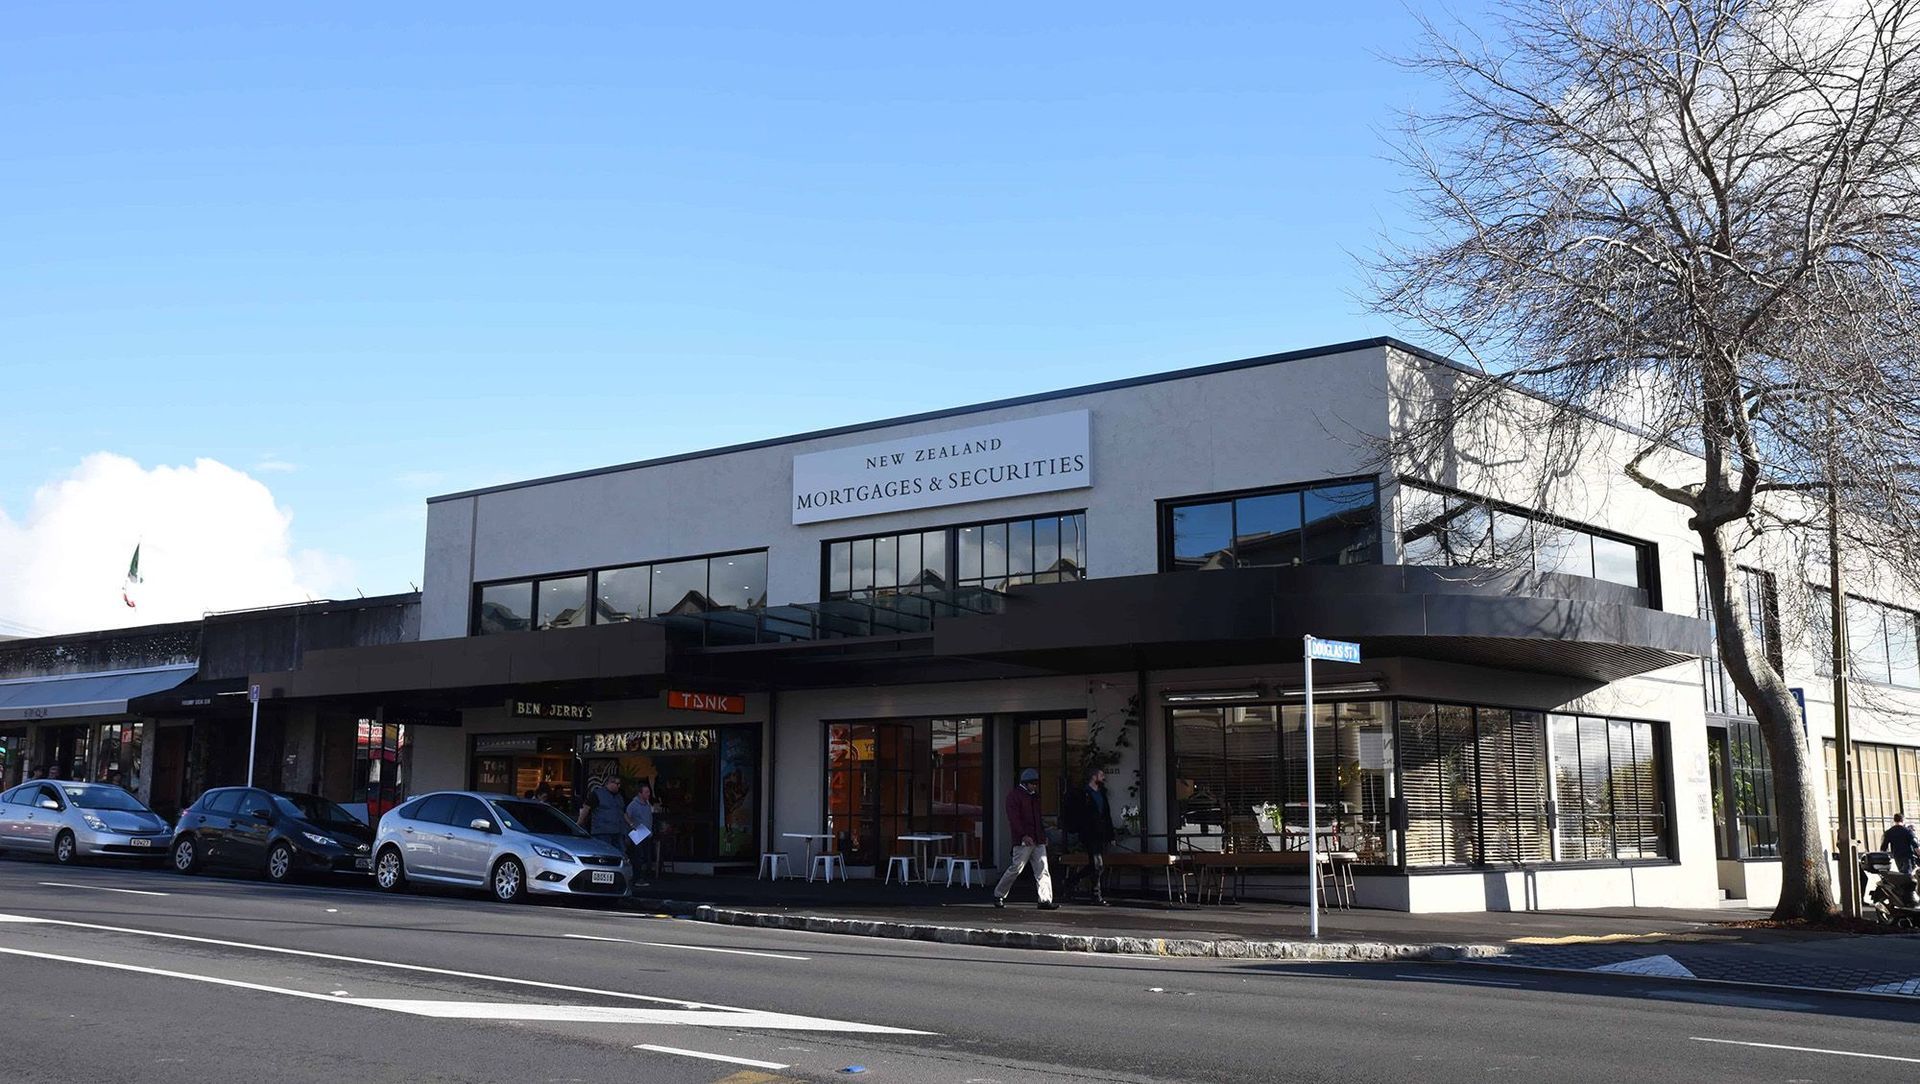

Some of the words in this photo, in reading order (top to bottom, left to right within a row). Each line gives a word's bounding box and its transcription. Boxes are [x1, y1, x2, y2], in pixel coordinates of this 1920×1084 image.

[866, 452, 905, 469] NEW
[915, 438, 1003, 462] ZEALAND
[796, 477, 923, 510] MORTGAGES
[929, 476, 943, 491] &
[948, 454, 1085, 490] SECURITIES
[1312, 641, 1344, 657] DOUGLAS
[516, 701, 541, 715] BEN
[549, 703, 593, 718] JERRY'S
[682, 693, 727, 711] TANK
[593, 732, 628, 752] BEN
[641, 729, 709, 751] JERRY'S
